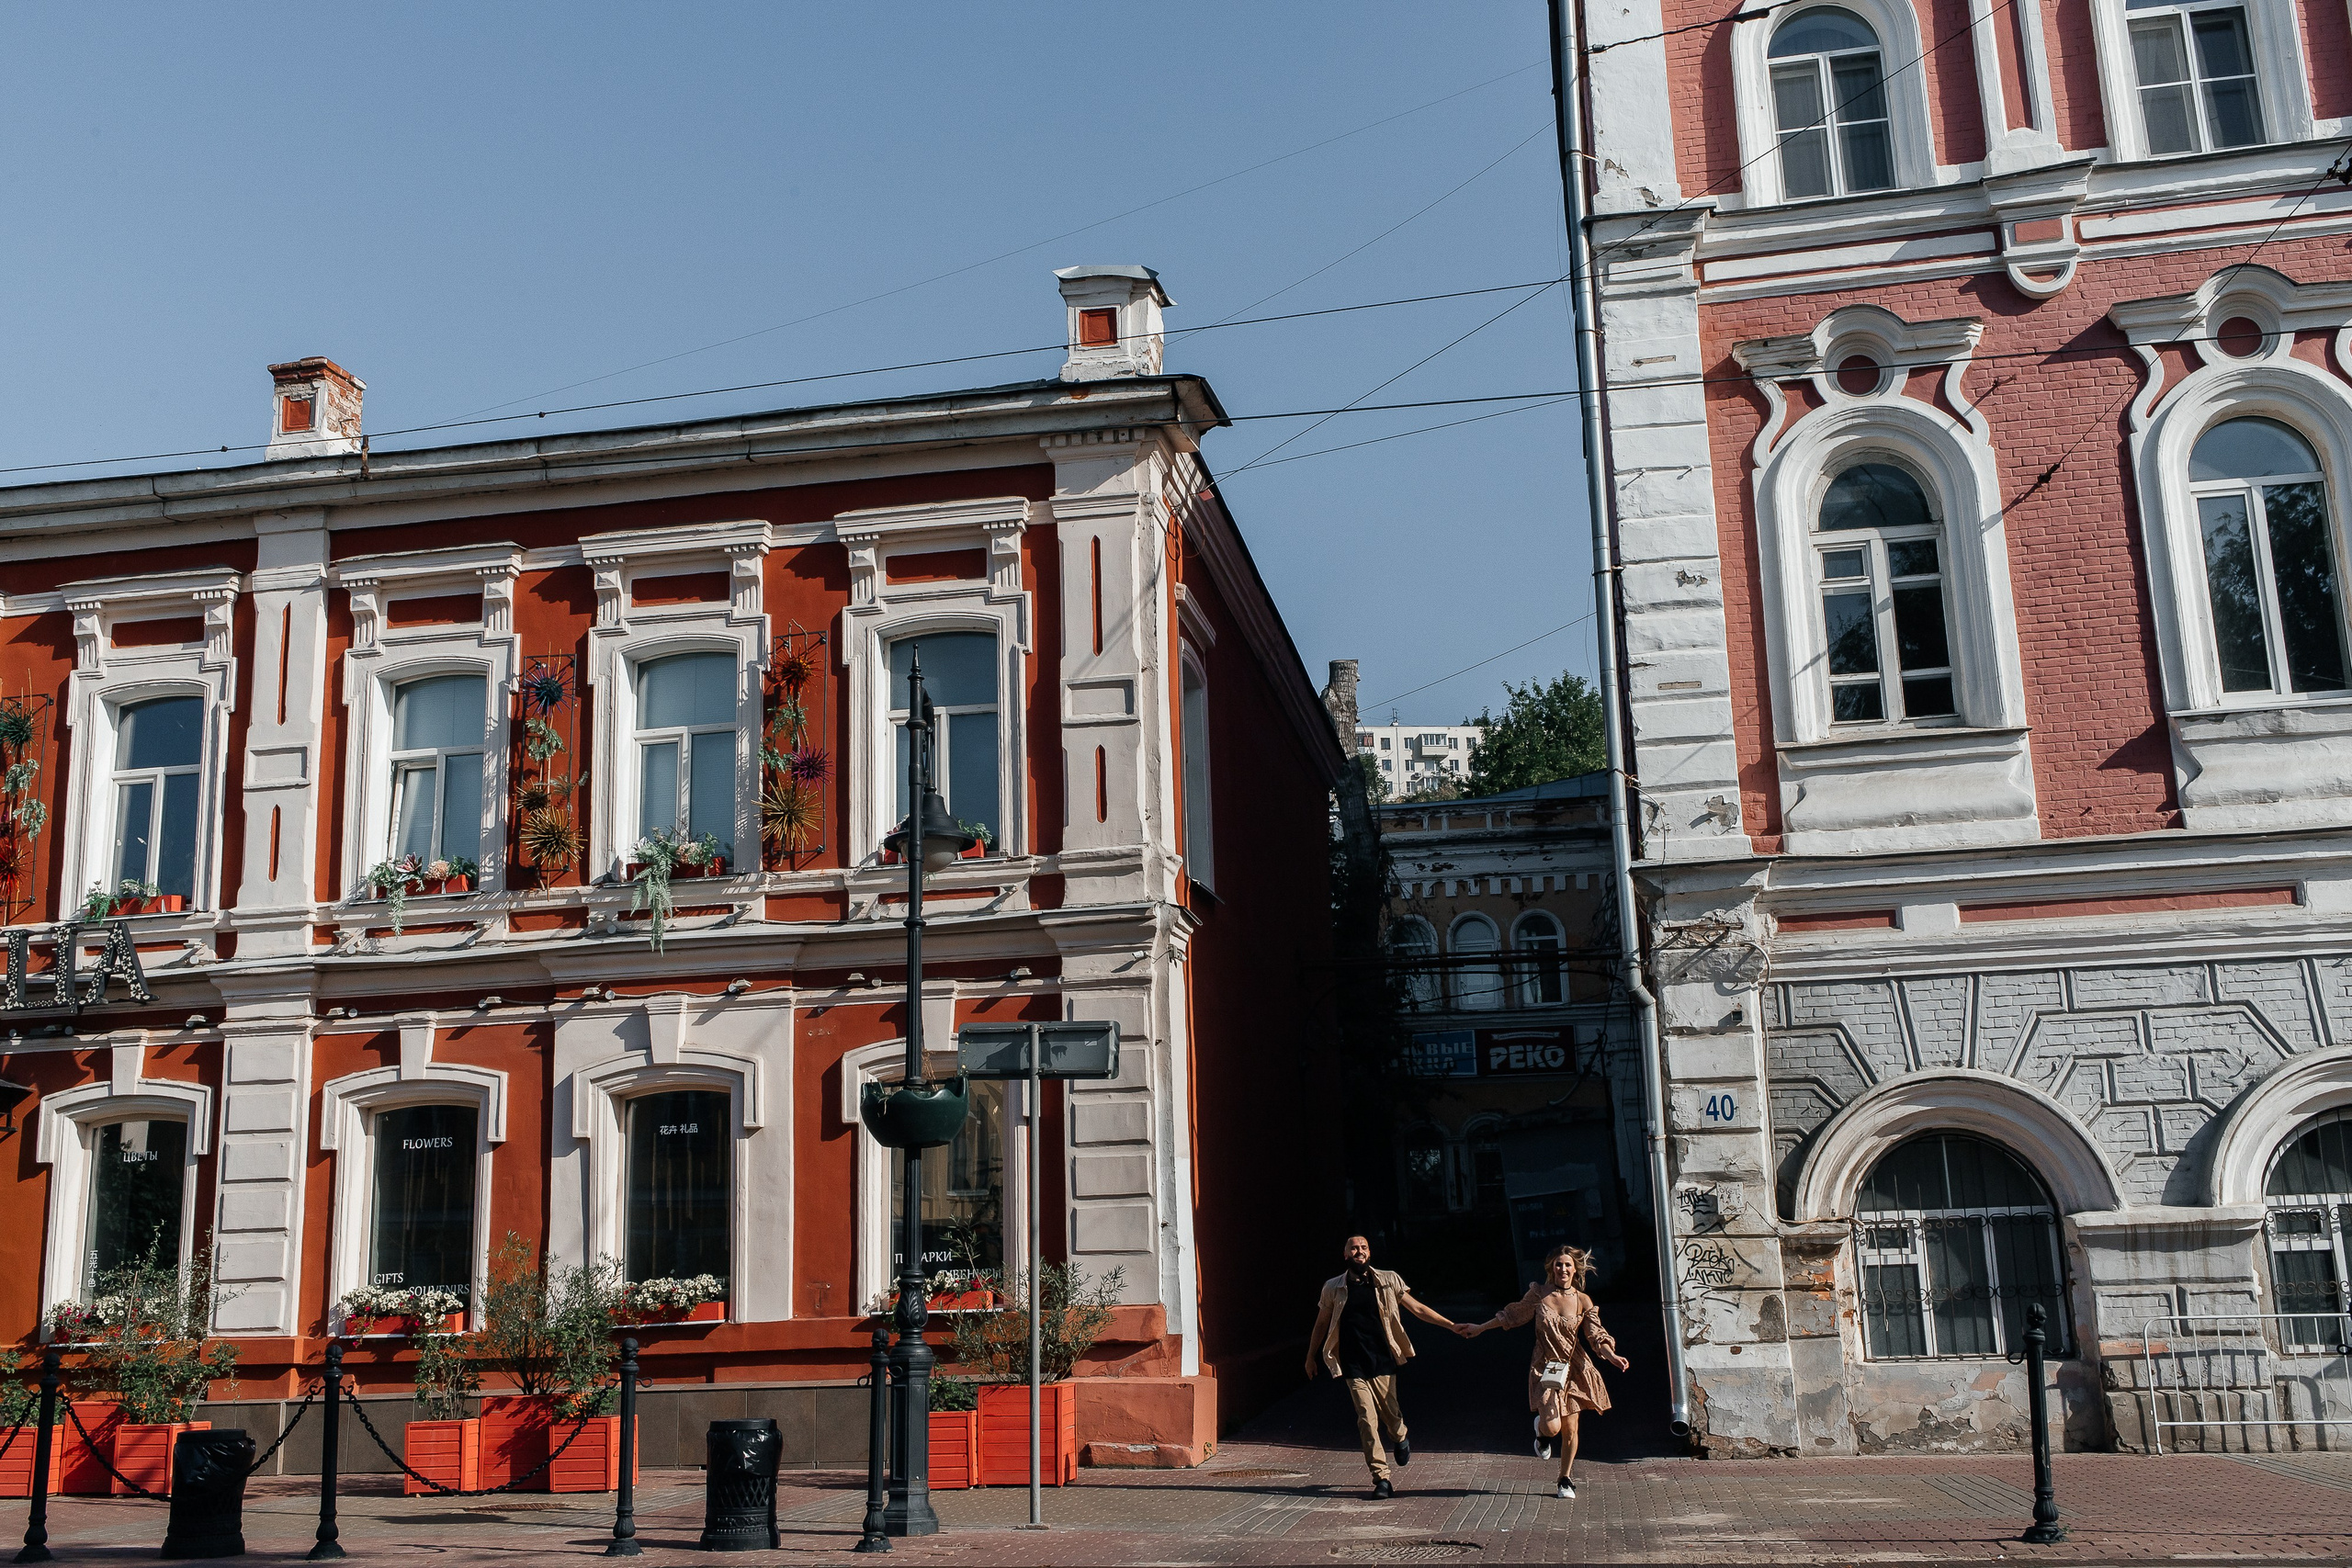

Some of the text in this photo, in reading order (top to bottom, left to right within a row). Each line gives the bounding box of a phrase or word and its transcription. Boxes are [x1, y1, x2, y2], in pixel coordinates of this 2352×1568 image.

[1489, 1044, 1566, 1070] РЕКО
[1706, 1095, 1735, 1121] 40
[659, 1123, 698, 1135] 花卉 礼品
[402, 1136, 453, 1150] FLOWERS
[123, 1150, 158, 1163] ЦВЕТЫ
[895, 1251, 953, 1264] ПАРКИ
[87, 1249, 98, 1288] 五光十色
[374, 1272, 403, 1284] GIFTS
[409, 1283, 470, 1297] SOUVENIRS
